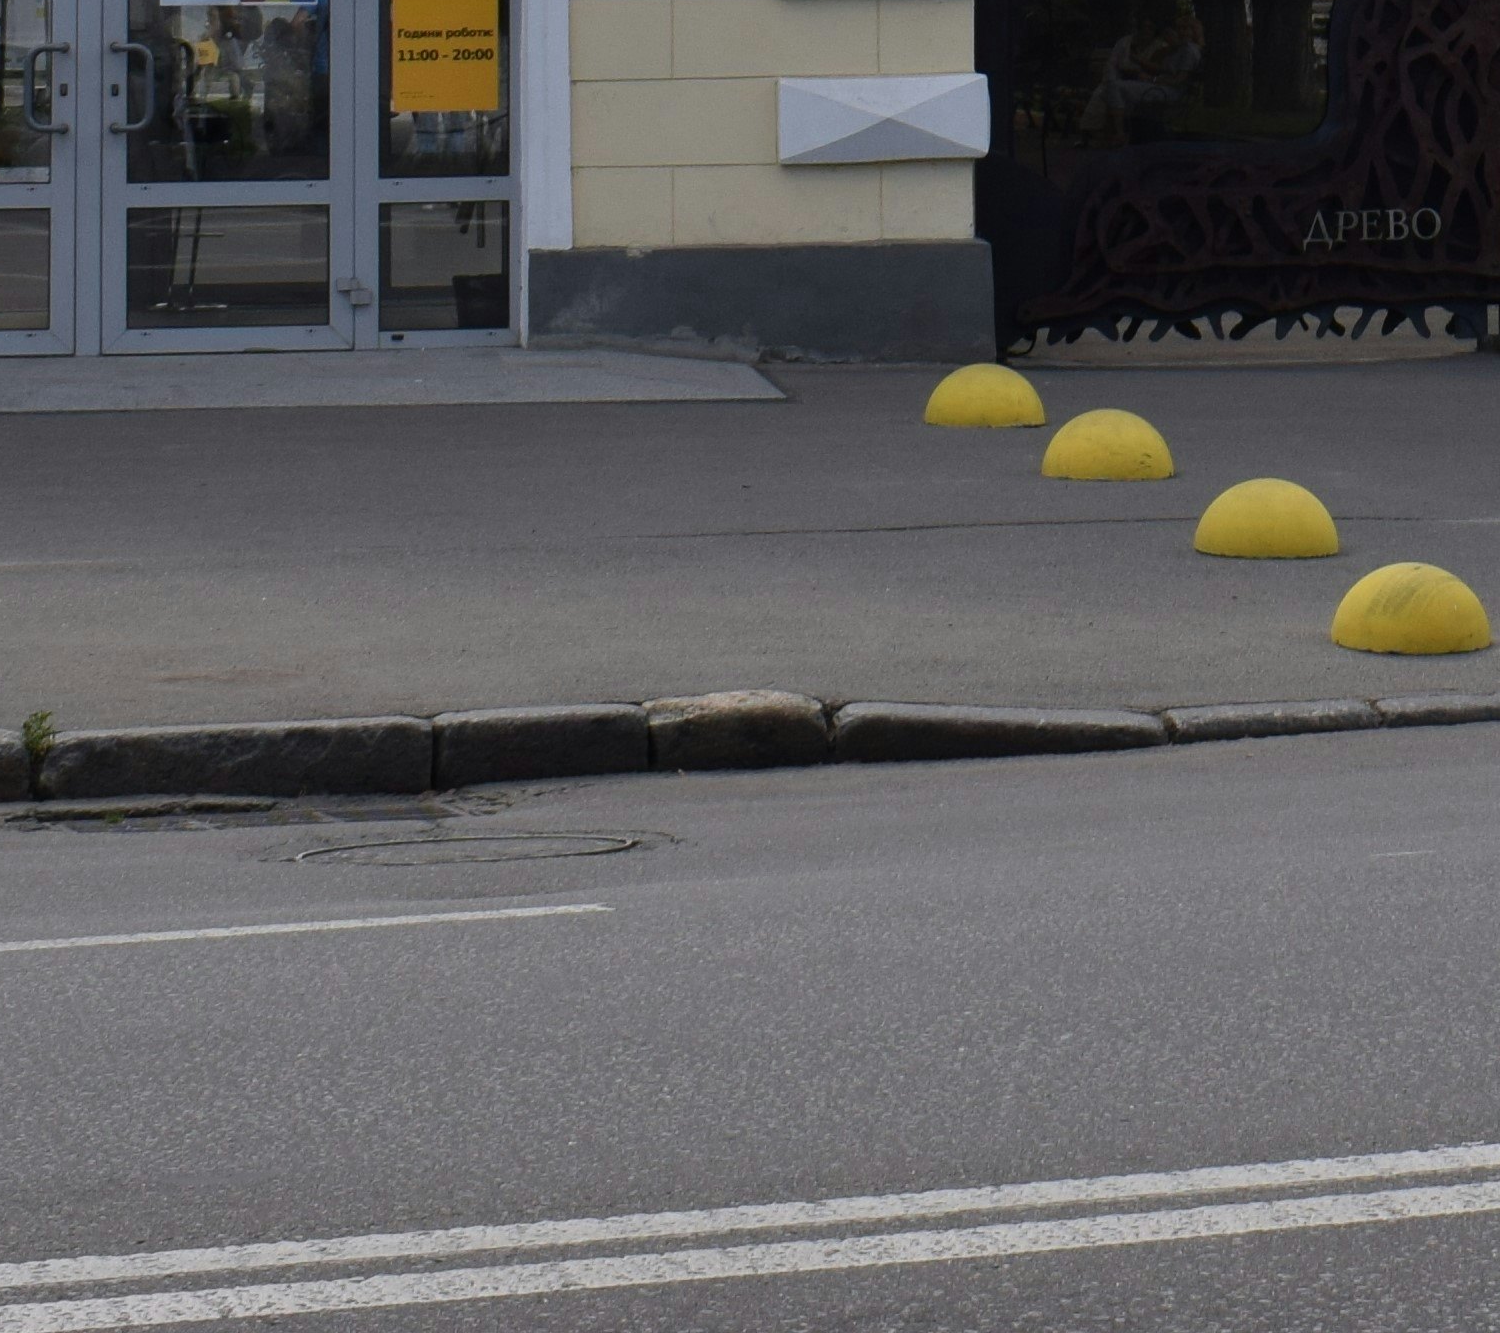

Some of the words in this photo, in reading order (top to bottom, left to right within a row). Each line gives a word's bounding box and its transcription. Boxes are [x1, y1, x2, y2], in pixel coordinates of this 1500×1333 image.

[397, 28, 443, 39] Години
[397, 48, 439, 62] 11:00
[452, 47, 495, 62] 20:00
[1303, 207, 1442, 252] ДРЕВО
